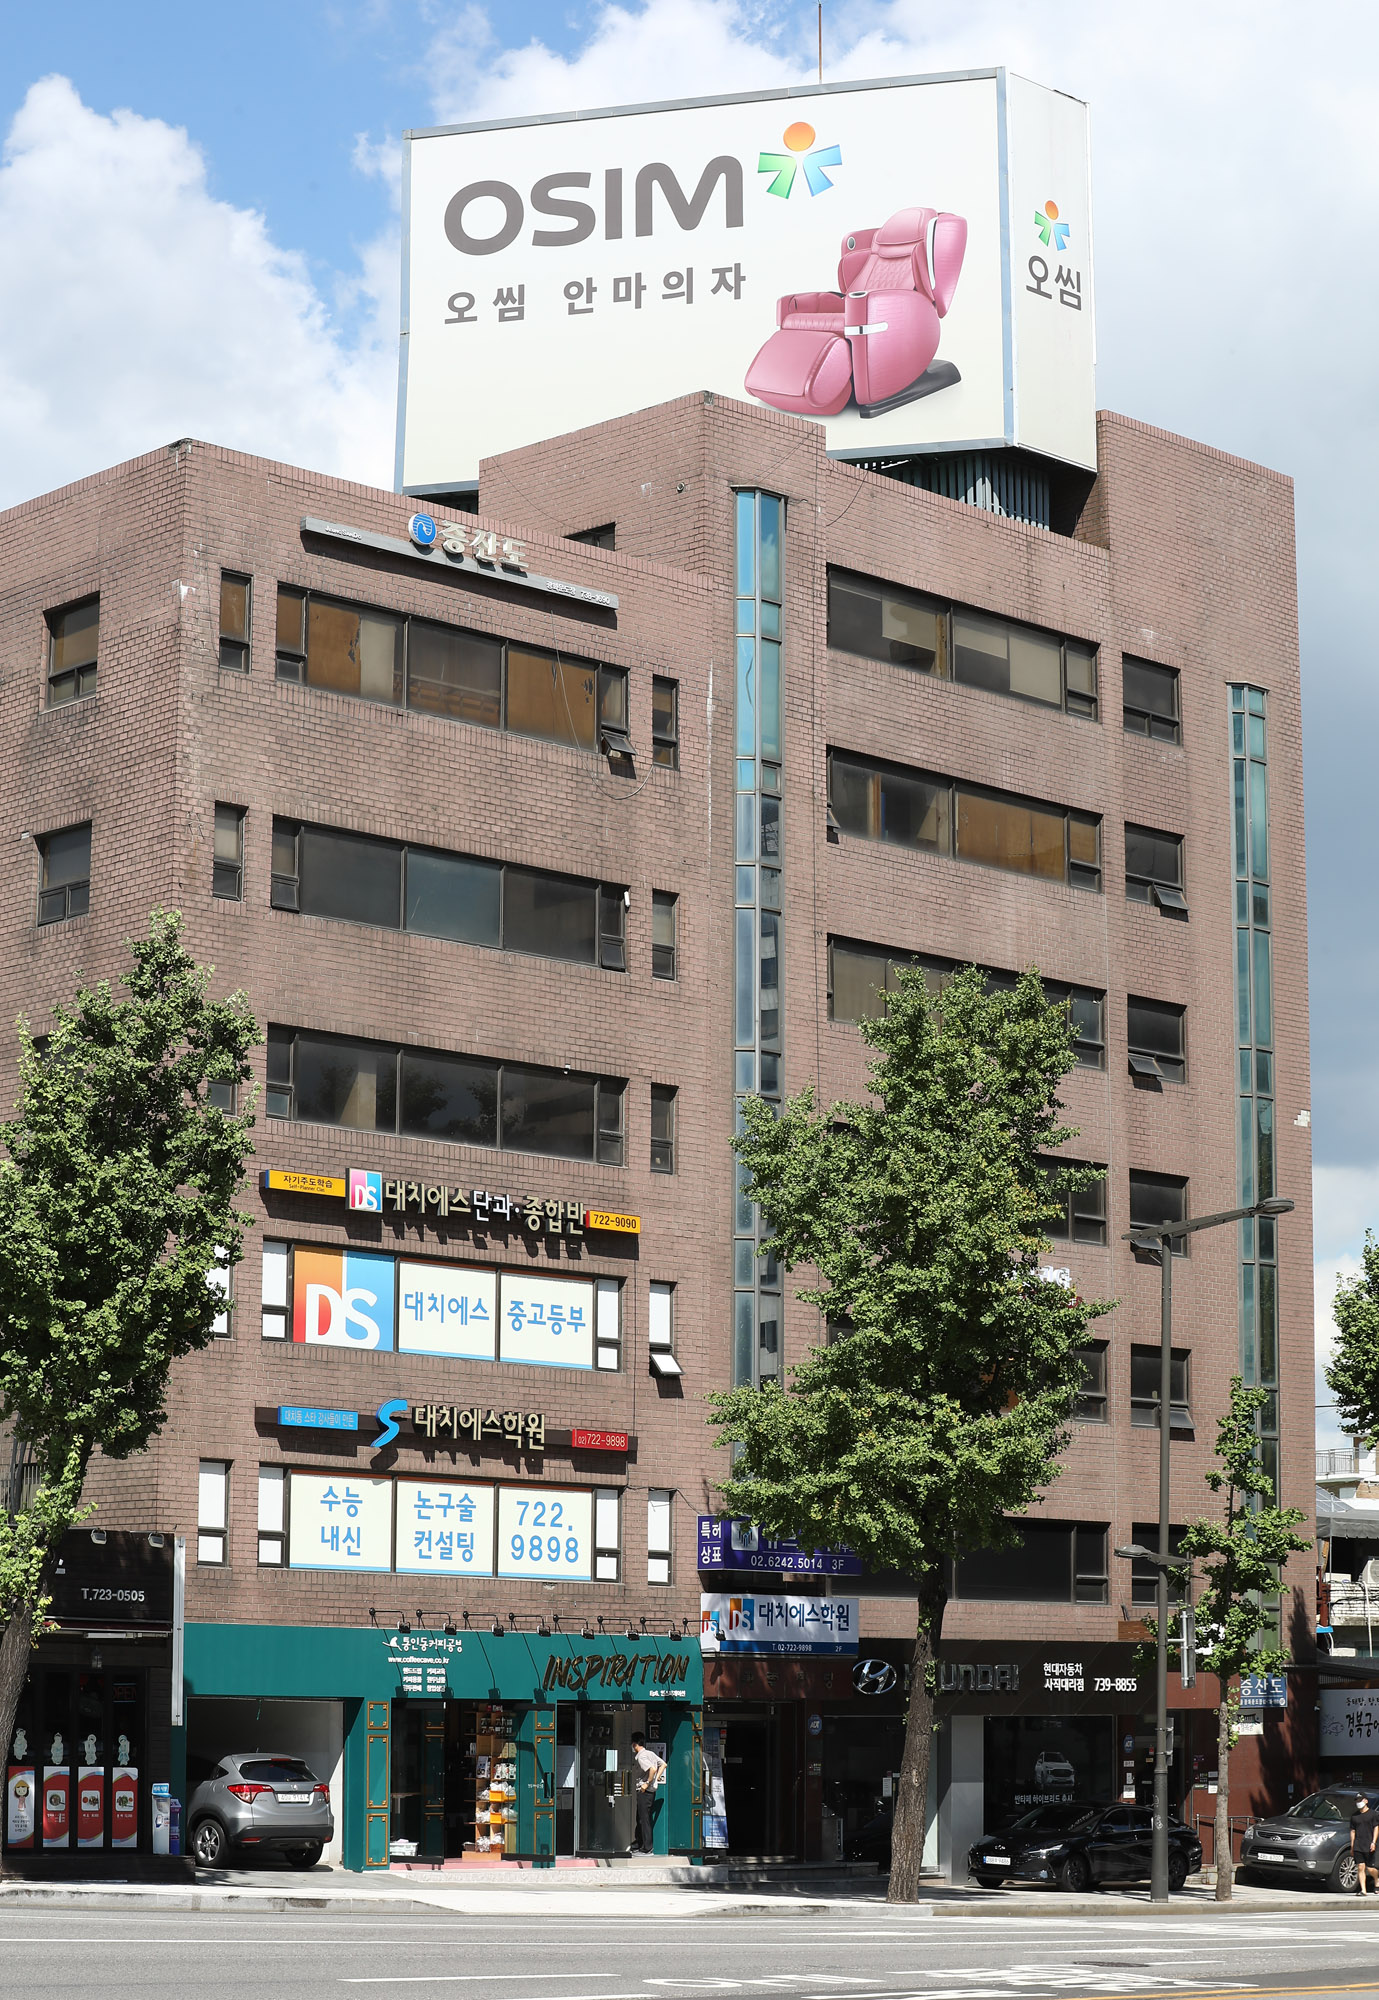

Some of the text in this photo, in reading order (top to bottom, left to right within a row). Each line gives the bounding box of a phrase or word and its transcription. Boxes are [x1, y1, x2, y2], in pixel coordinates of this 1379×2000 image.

[443, 155, 744, 256] OSIM
[1025, 254, 1082, 311] 오씸
[443, 283, 525, 325] 오씸
[439, 519, 529, 569] 증산도
[283, 1175, 333, 1188] 자기주도학습
[352, 1185, 379, 1211] DS
[593, 1213, 637, 1229] 722-9090
[305, 1283, 381, 1350] DS
[404, 1291, 490, 1325] 대치에스
[507, 1300, 586, 1335] 중고등부
[415, 1404, 546, 1451] 대치에스학원
[320, 1485, 363, 1518] 수능
[413, 1490, 477, 1523] 논구술
[321, 1525, 362, 1557] 내신
[700, 1521, 722, 1538] 특허
[413, 1530, 475, 1563] 컨설팅
[511, 1534, 579, 1564] 9898
[700, 1546, 722, 1564] 상표
[750, 1555, 844, 1570] 02.6242.5014 3F
[81, 1588, 145, 1602] T.723-0505
[758, 1602, 850, 1632] 대치에스학원
[542, 1654, 690, 1691] INSPIRATION
[1043, 1662, 1083, 1676] 현대자동차
[1043, 1677, 1137, 1692] 사직대리점 739-8855
